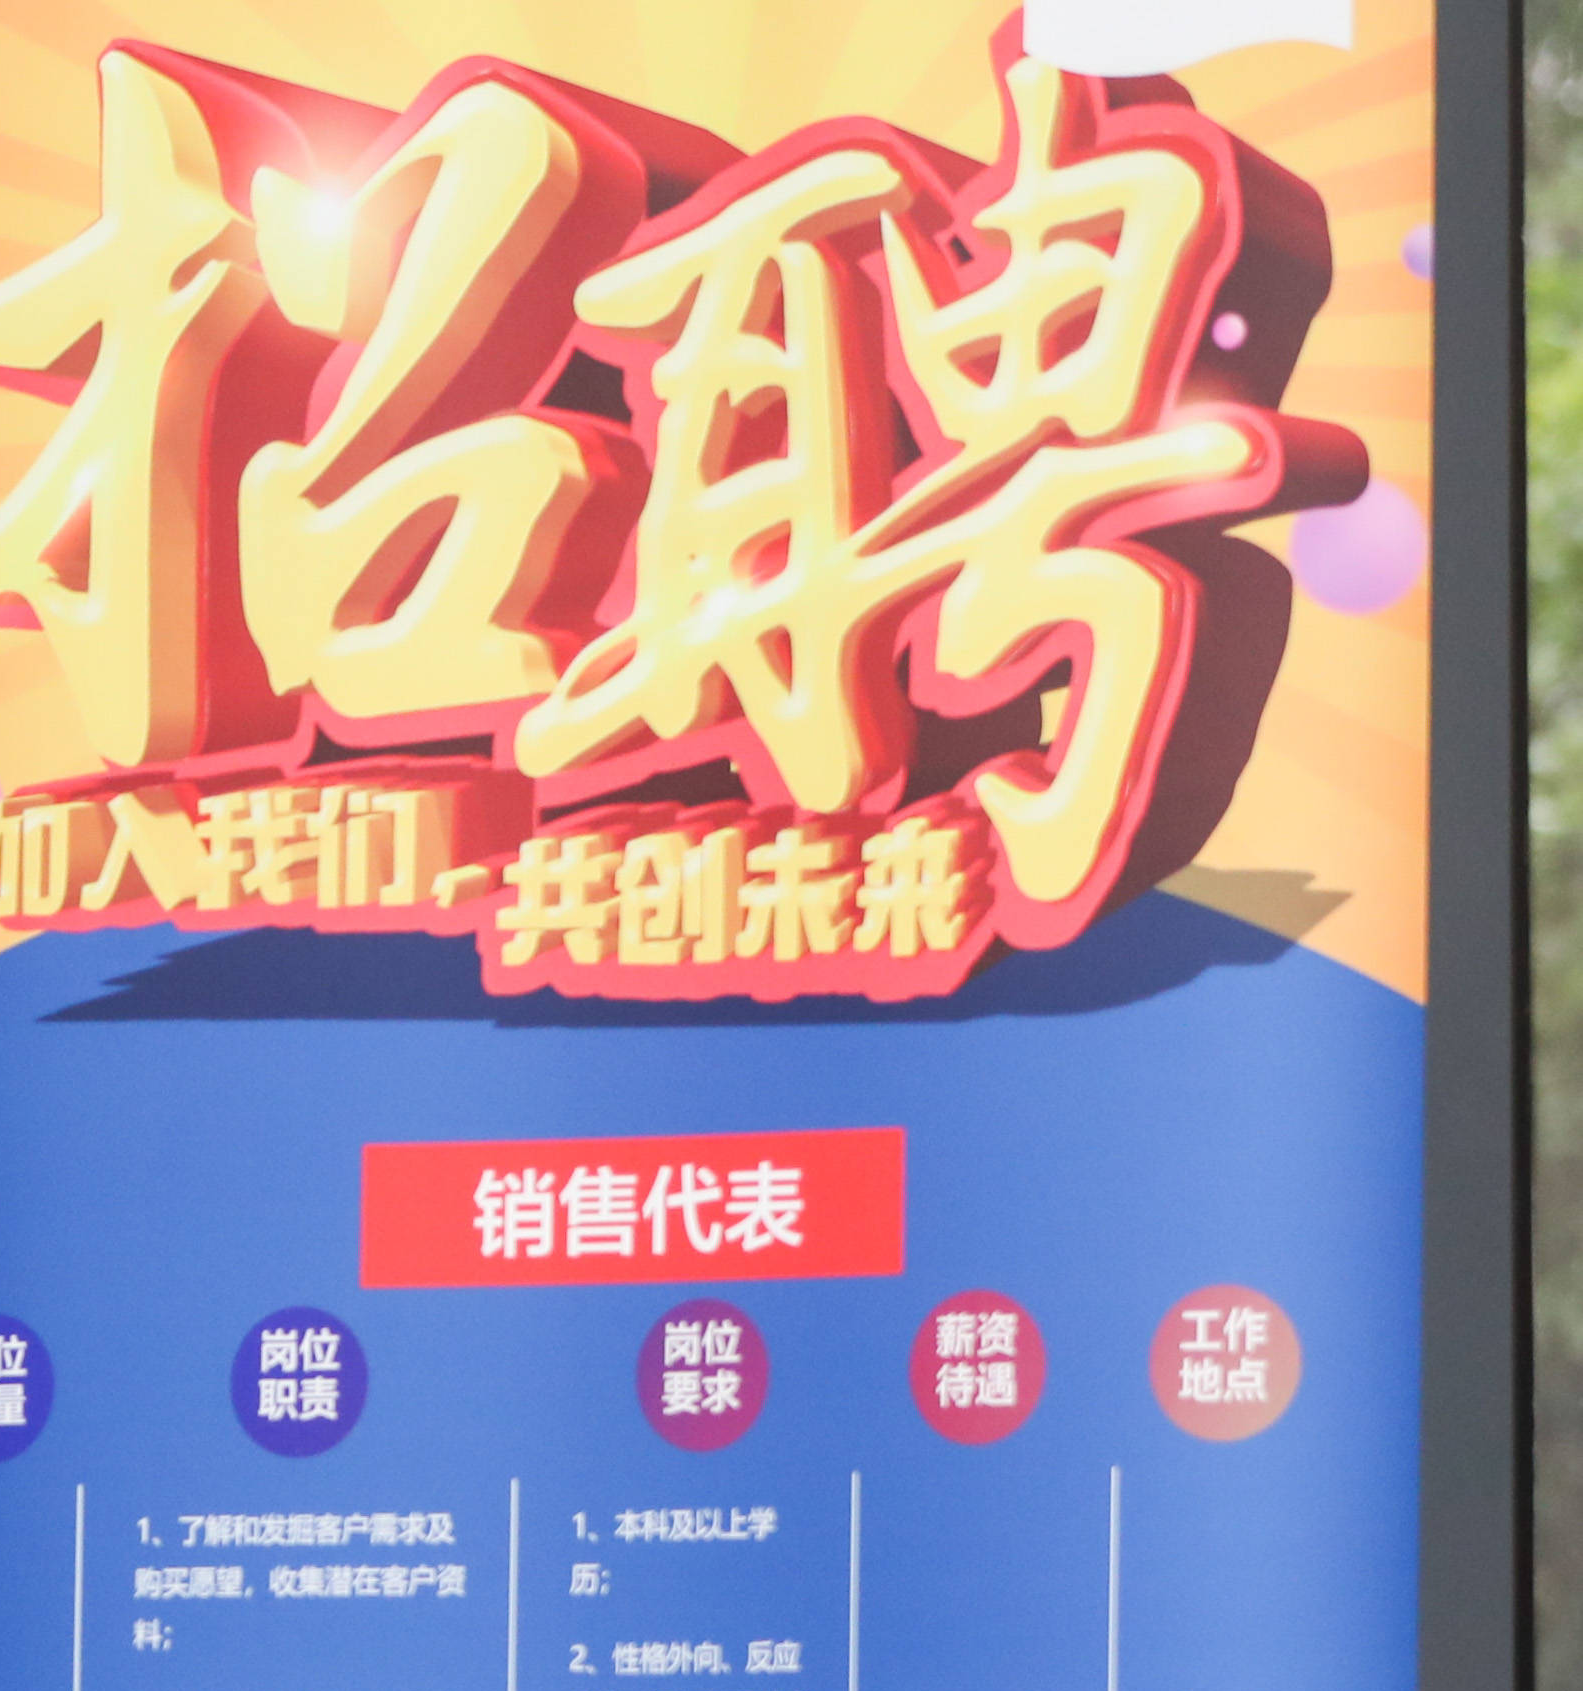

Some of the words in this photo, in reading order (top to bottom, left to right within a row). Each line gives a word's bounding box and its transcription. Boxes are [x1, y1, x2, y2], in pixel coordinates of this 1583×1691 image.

[495, 814, 968, 968] 共创未来
[473, 1161, 804, 1259] 销售代表
[261, 1328, 340, 1373] 岗位
[665, 1319, 741, 1366] 岗位
[937, 1311, 1018, 1358] 薪资
[1180, 1307, 1270, 1353] 工作
[258, 1376, 339, 1421] 职责
[662, 1368, 741, 1415] 要求
[936, 1362, 1017, 1407] 待遇
[1179, 1357, 1268, 1402] 地点
[573, 1507, 777, 1541] 1、本科及以上学
